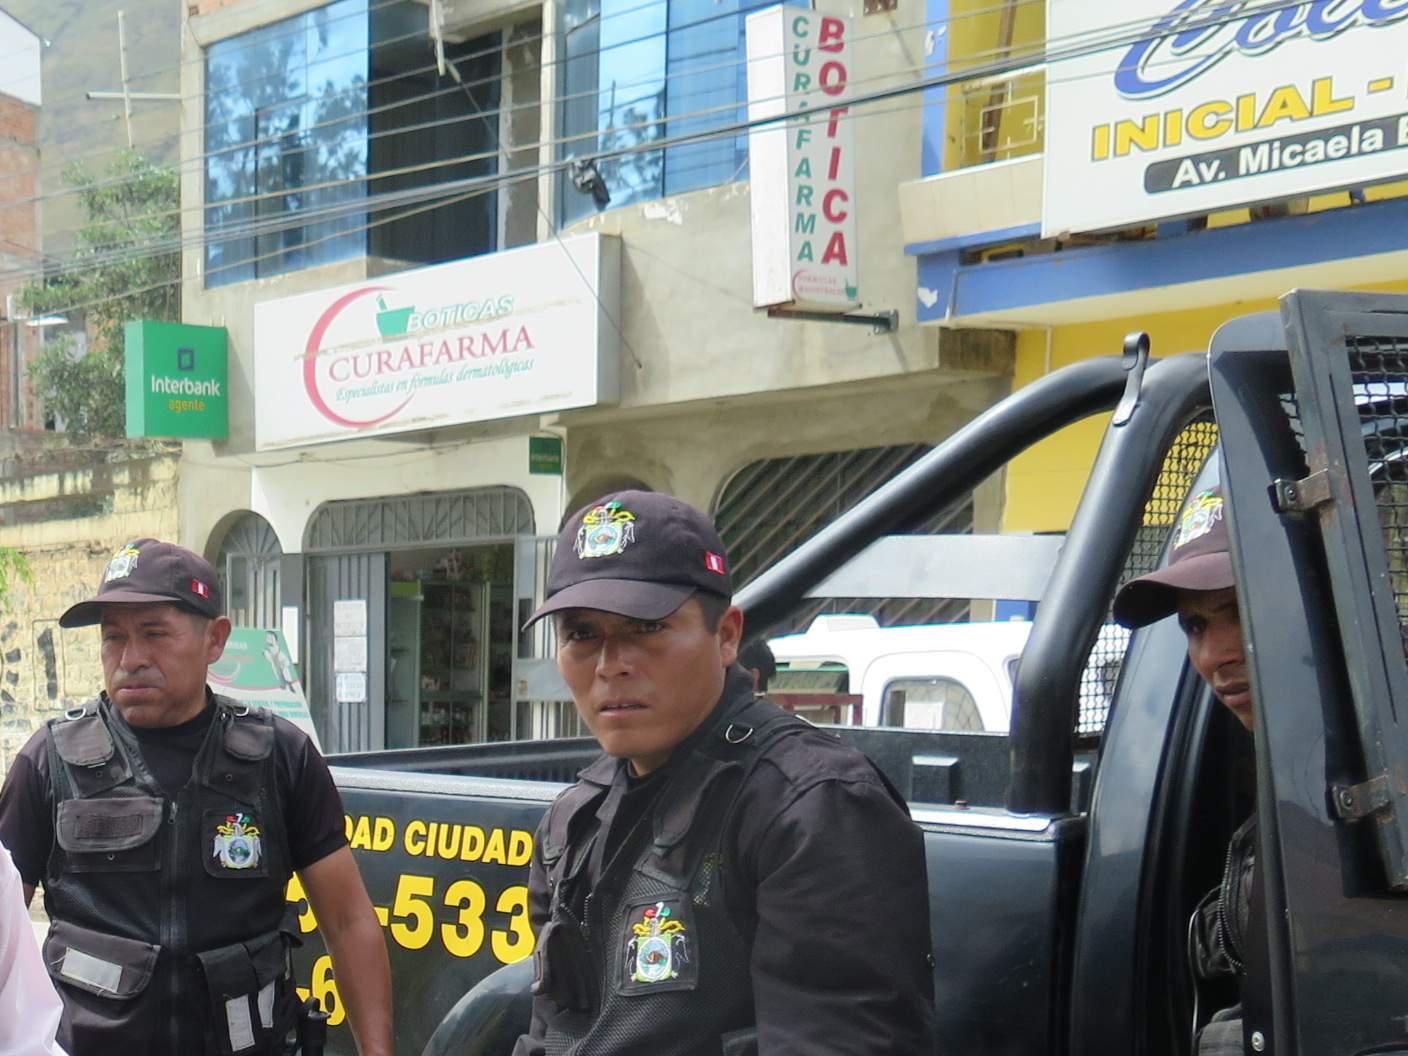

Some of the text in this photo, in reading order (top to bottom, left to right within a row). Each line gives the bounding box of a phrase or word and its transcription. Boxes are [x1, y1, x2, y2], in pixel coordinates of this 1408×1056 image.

[792, 16, 817, 262] CURAFARMA
[818, 17, 849, 266] BOTICA
[1092, 77, 1355, 162] INICIAL
[1171, 158, 1226, 189] Av.
[1239, 124, 1384, 176] Micaela
[406, 294, 515, 332] BOTICAS
[151, 374, 221, 397] Interbank
[328, 325, 535, 382] CURAFARMA
